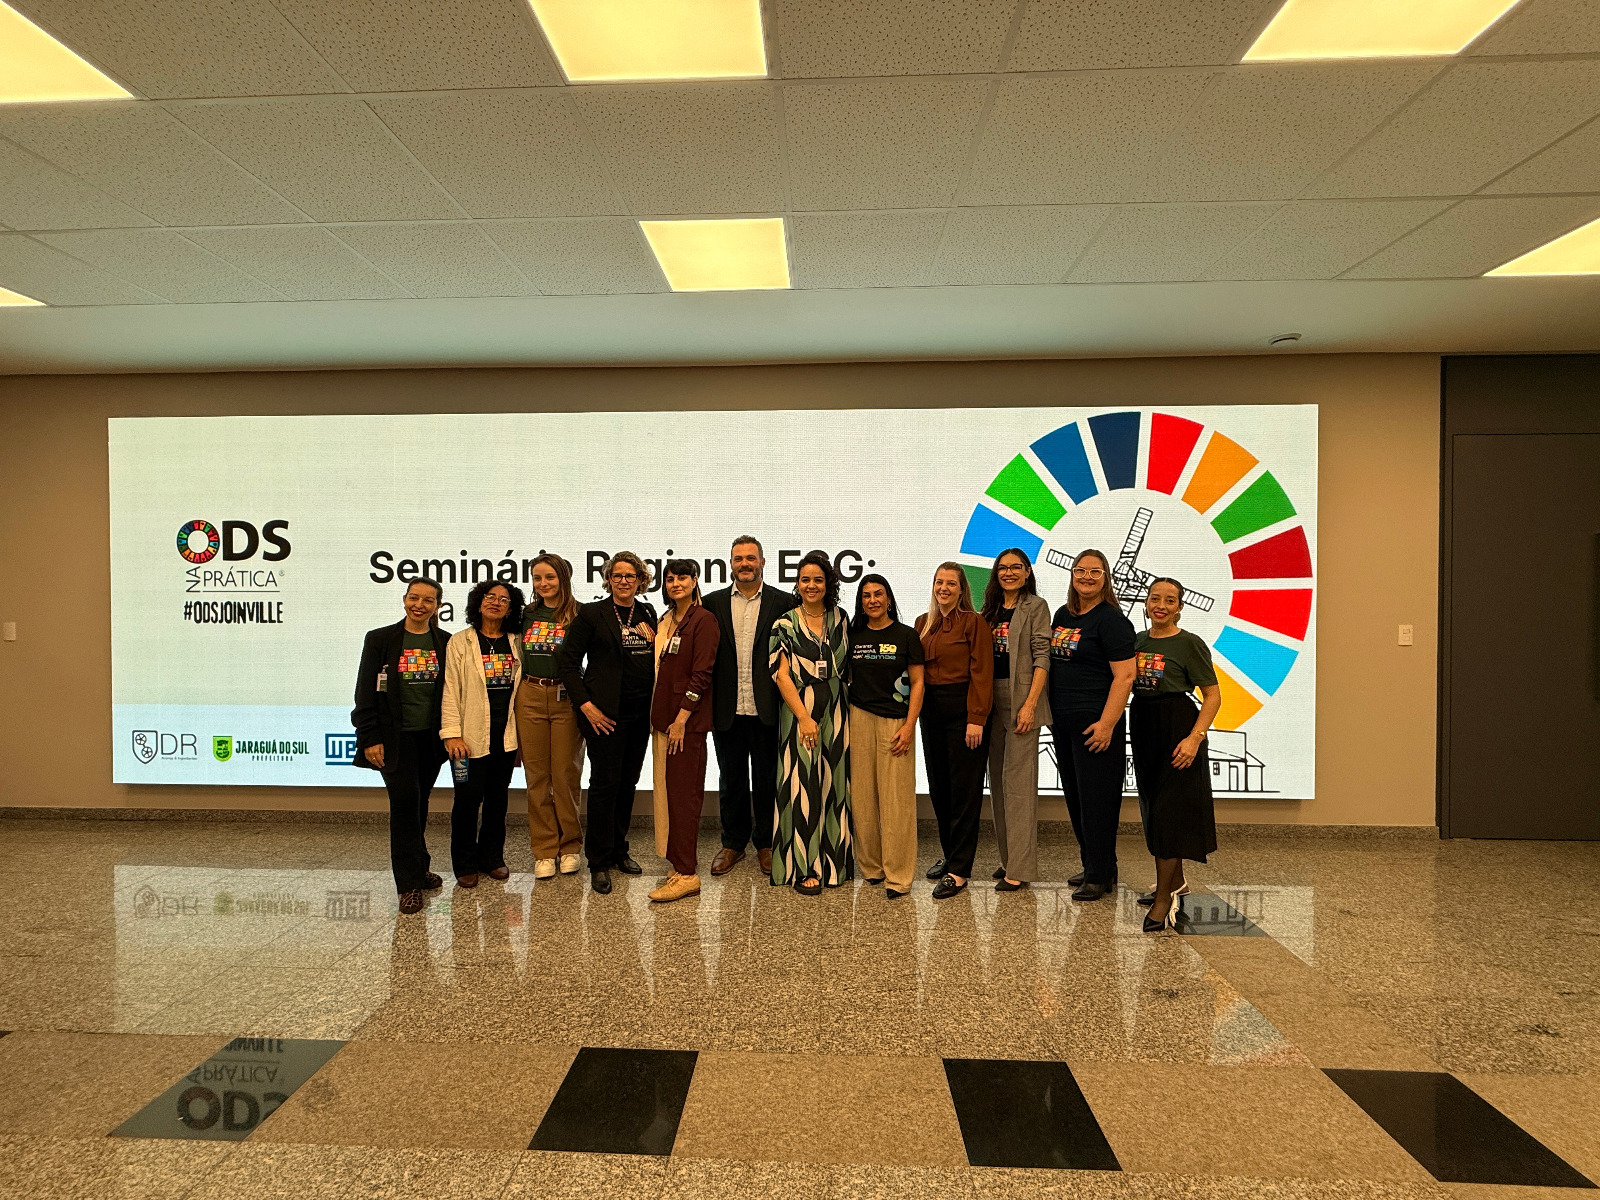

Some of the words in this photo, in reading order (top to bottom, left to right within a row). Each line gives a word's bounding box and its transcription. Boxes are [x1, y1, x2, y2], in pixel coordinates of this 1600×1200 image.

[176, 519, 292, 564] ODS
[369, 549, 573, 584] Seminár
[186, 566, 200, 593] NA
[184, 601, 284, 624] #ODSJOINVILLE
[161, 733, 197, 755] DR
[236, 739, 277, 754] JARAGUÁ
[279, 741, 291, 754] DO
[293, 742, 309, 754] SUL
